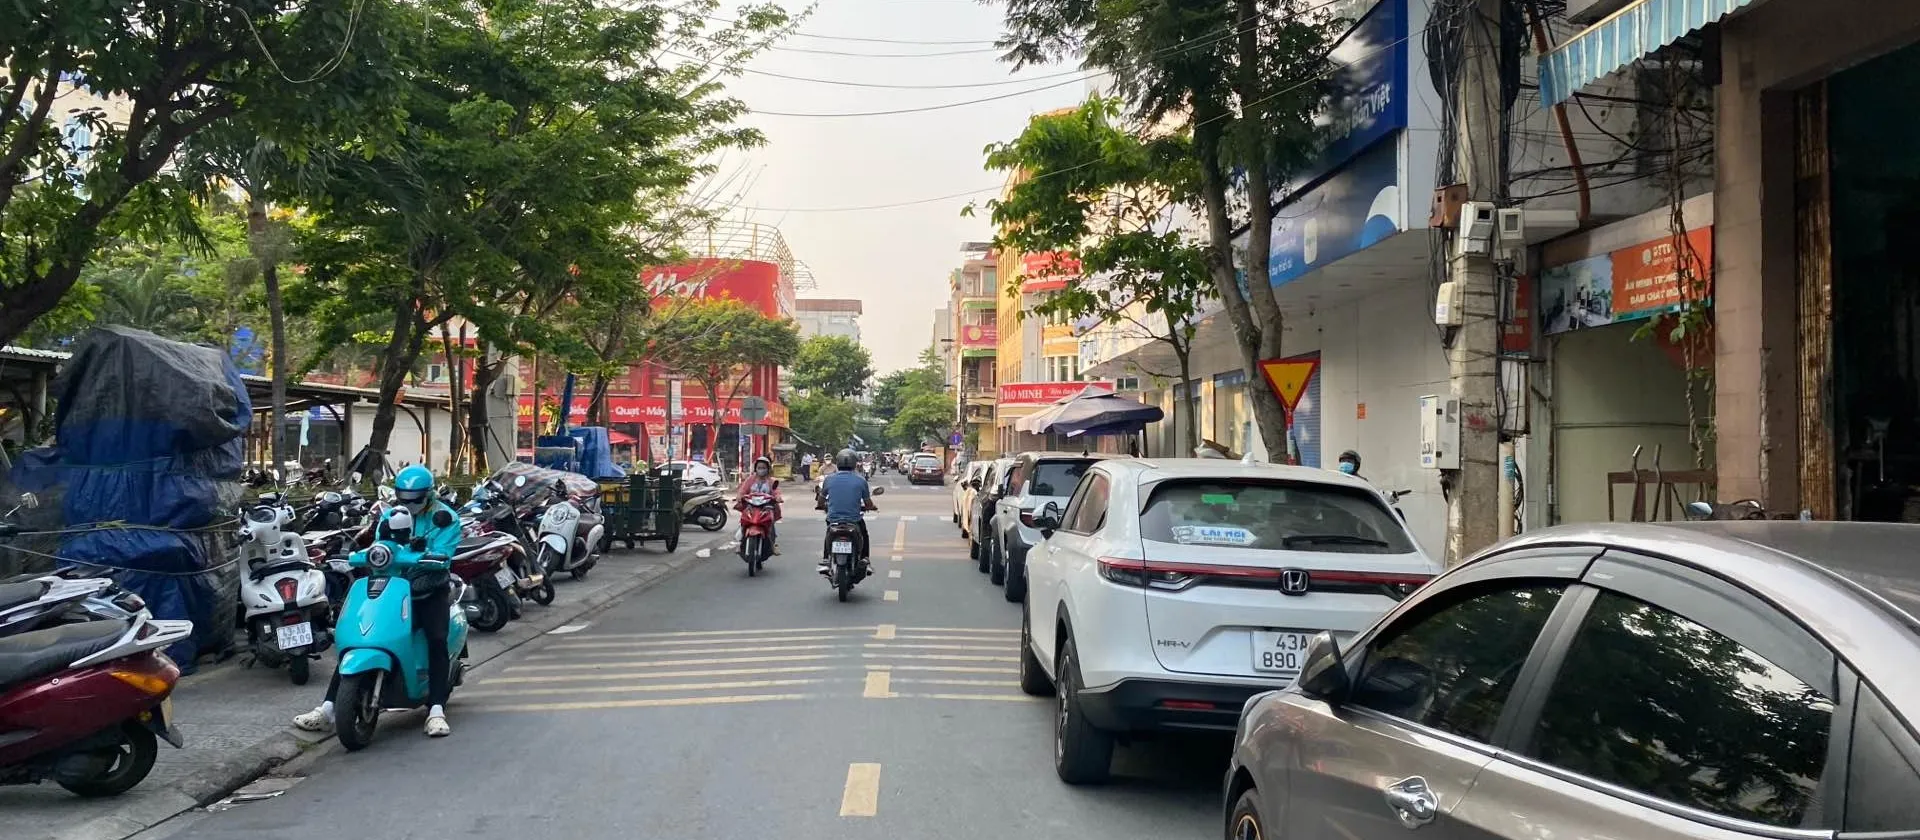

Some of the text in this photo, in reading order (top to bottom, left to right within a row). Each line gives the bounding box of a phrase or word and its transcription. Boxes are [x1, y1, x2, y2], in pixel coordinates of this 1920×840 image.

[1371, 84, 1391, 113] Việt
[1018, 389, 1042, 399] MINH
[615, 406, 637, 417] Quạt
[646, 404, 667, 417] Máy
[1157, 639, 1191, 649] HR-V
